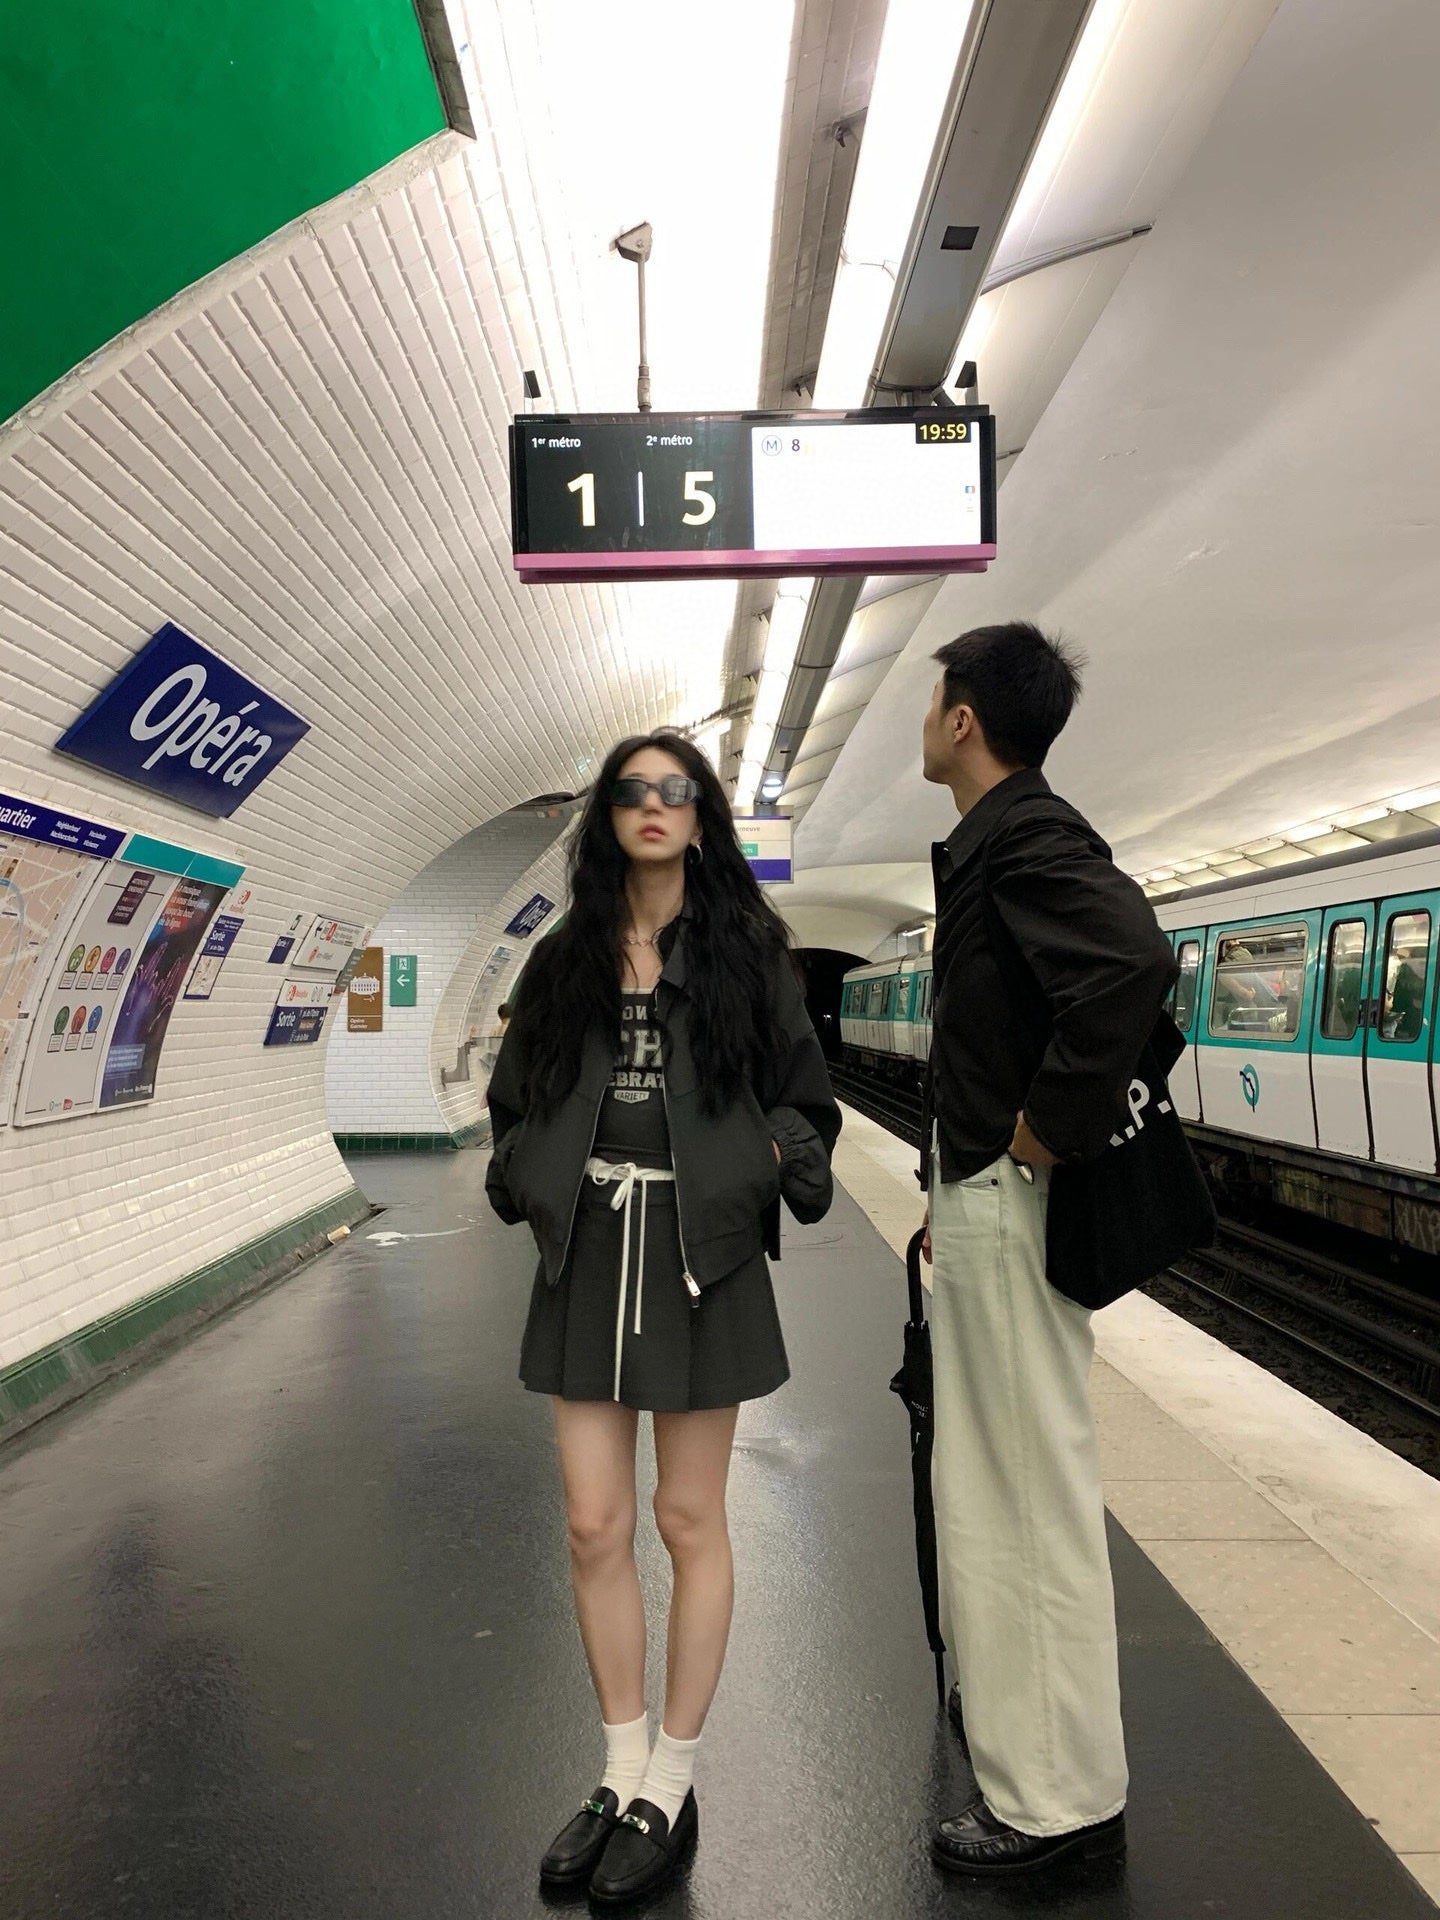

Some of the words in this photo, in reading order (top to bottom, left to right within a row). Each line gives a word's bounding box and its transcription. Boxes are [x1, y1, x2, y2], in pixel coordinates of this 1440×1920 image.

[645, 435, 658, 446] 2e
[660, 435, 693, 446] métro
[919, 423, 968, 441] 19:59
[548, 436, 582, 448] métro
[791, 438, 801, 452] 8
[567, 472, 596, 527] 1
[682, 470, 717, 526] 5
[129, 663, 273, 787] Opéra
[276, 1011, 296, 1027] Sortie
